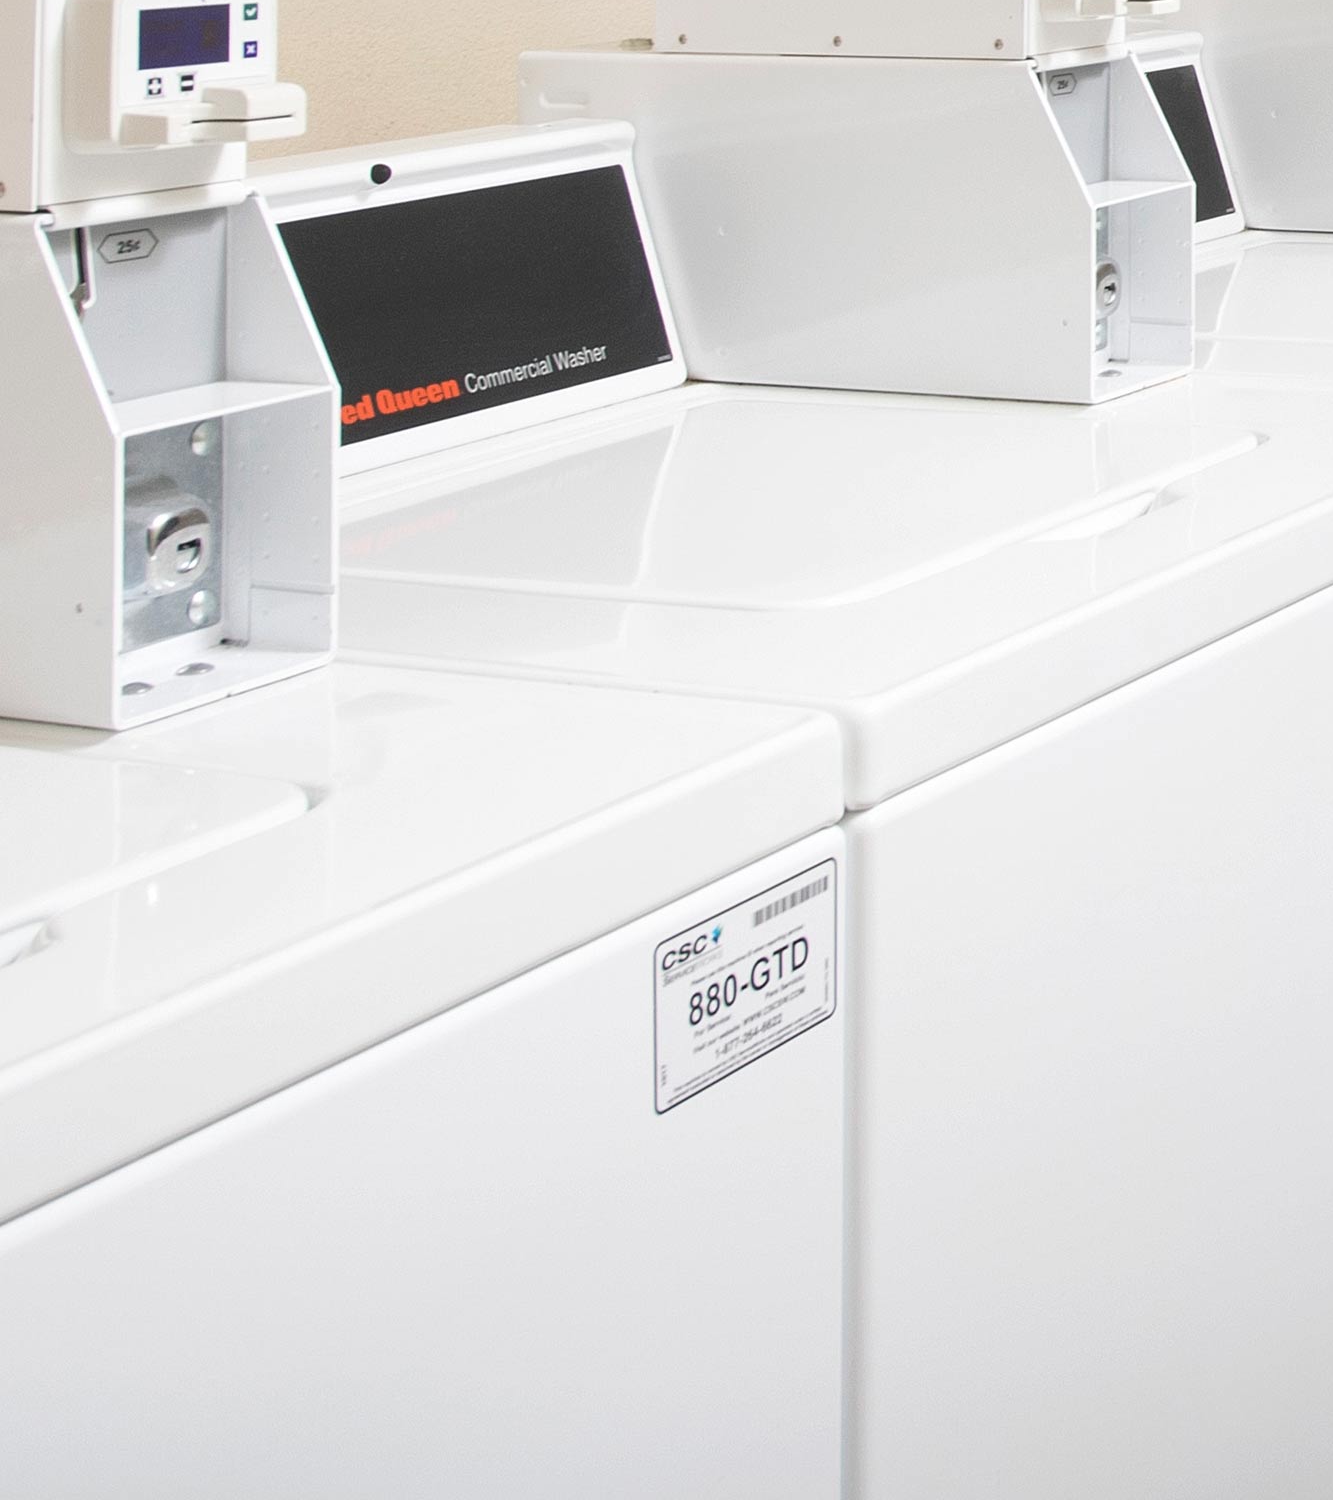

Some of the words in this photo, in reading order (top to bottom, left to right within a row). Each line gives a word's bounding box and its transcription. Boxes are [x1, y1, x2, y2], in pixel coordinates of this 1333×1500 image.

[341, 395, 374, 424] ed
[375, 378, 460, 415] Queen
[464, 356, 554, 394] Commercial
[553, 344, 608, 370] Washer
[662, 935, 707, 971] CSC
[689, 936, 809, 1025] 880-GTD
